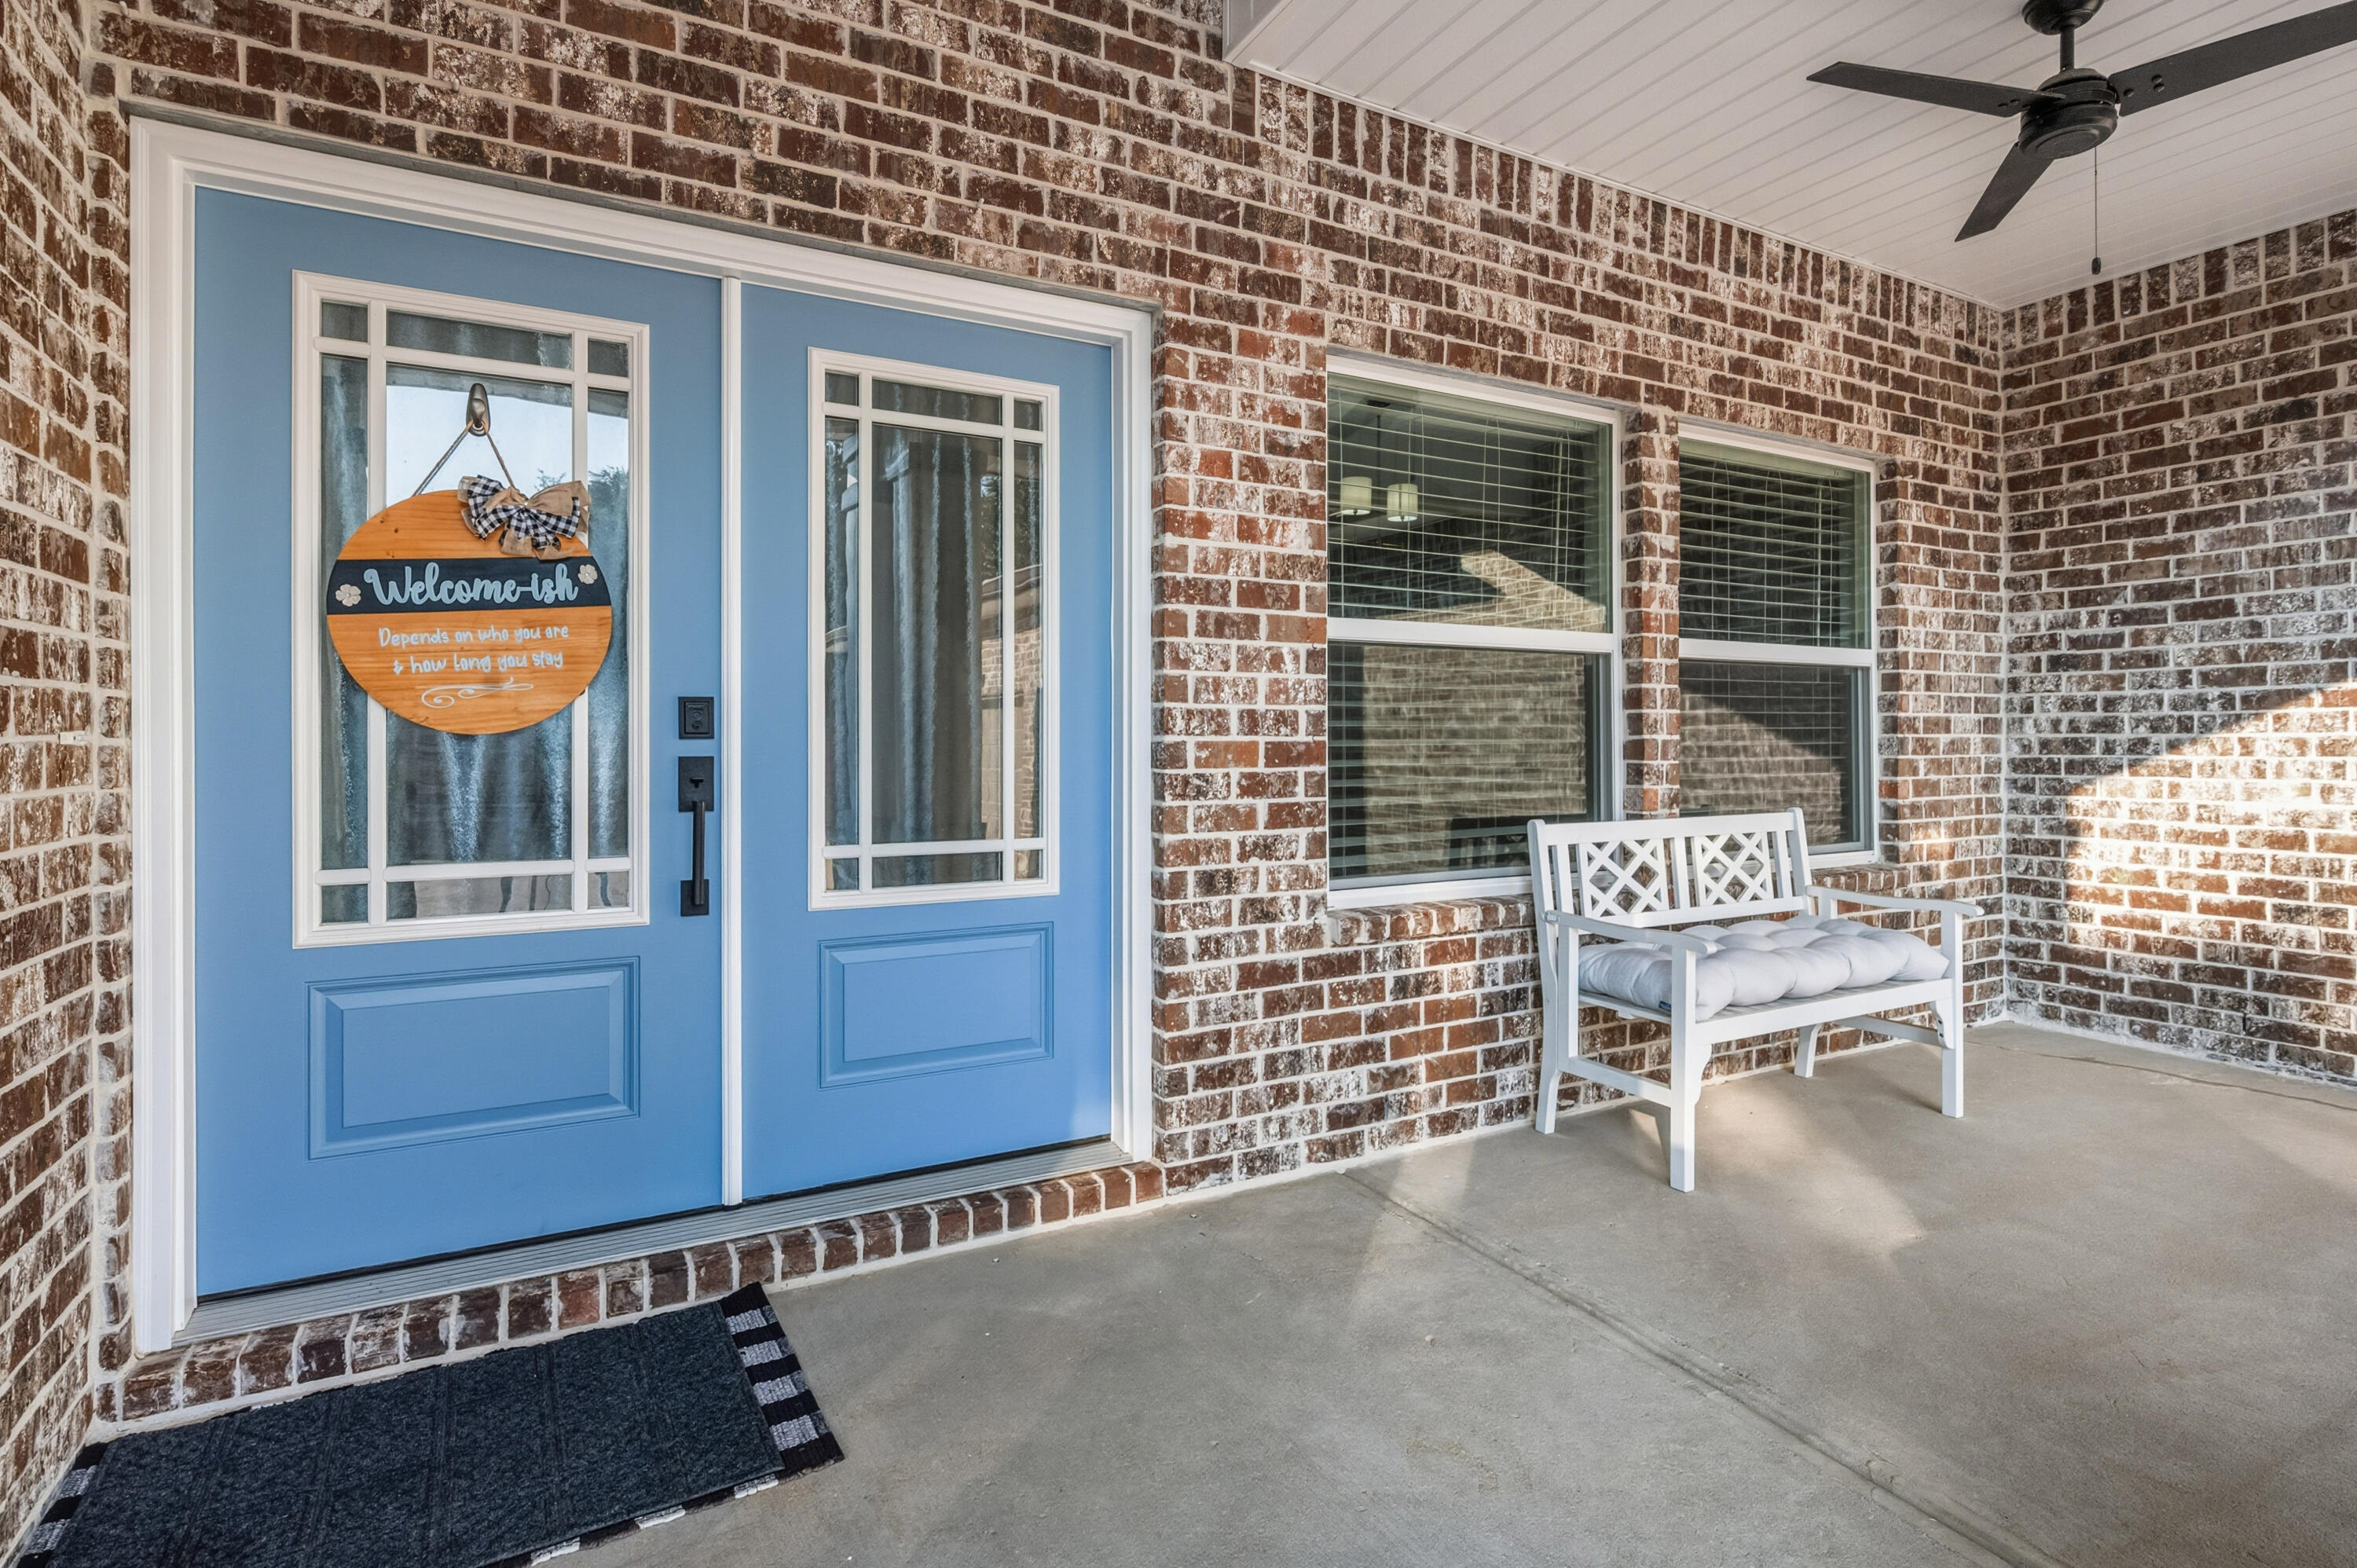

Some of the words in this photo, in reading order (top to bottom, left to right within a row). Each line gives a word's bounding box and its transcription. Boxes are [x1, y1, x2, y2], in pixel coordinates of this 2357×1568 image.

[363, 562, 578, 605] Welcome-ish
[378, 627, 449, 649] Depends
[455, 630, 473, 643] on
[477, 625, 509, 642] who
[514, 627, 541, 643] you
[545, 625, 569, 639] are
[410, 655, 447, 674] how
[497, 654, 527, 671] you
[532, 651, 563, 669] stay
